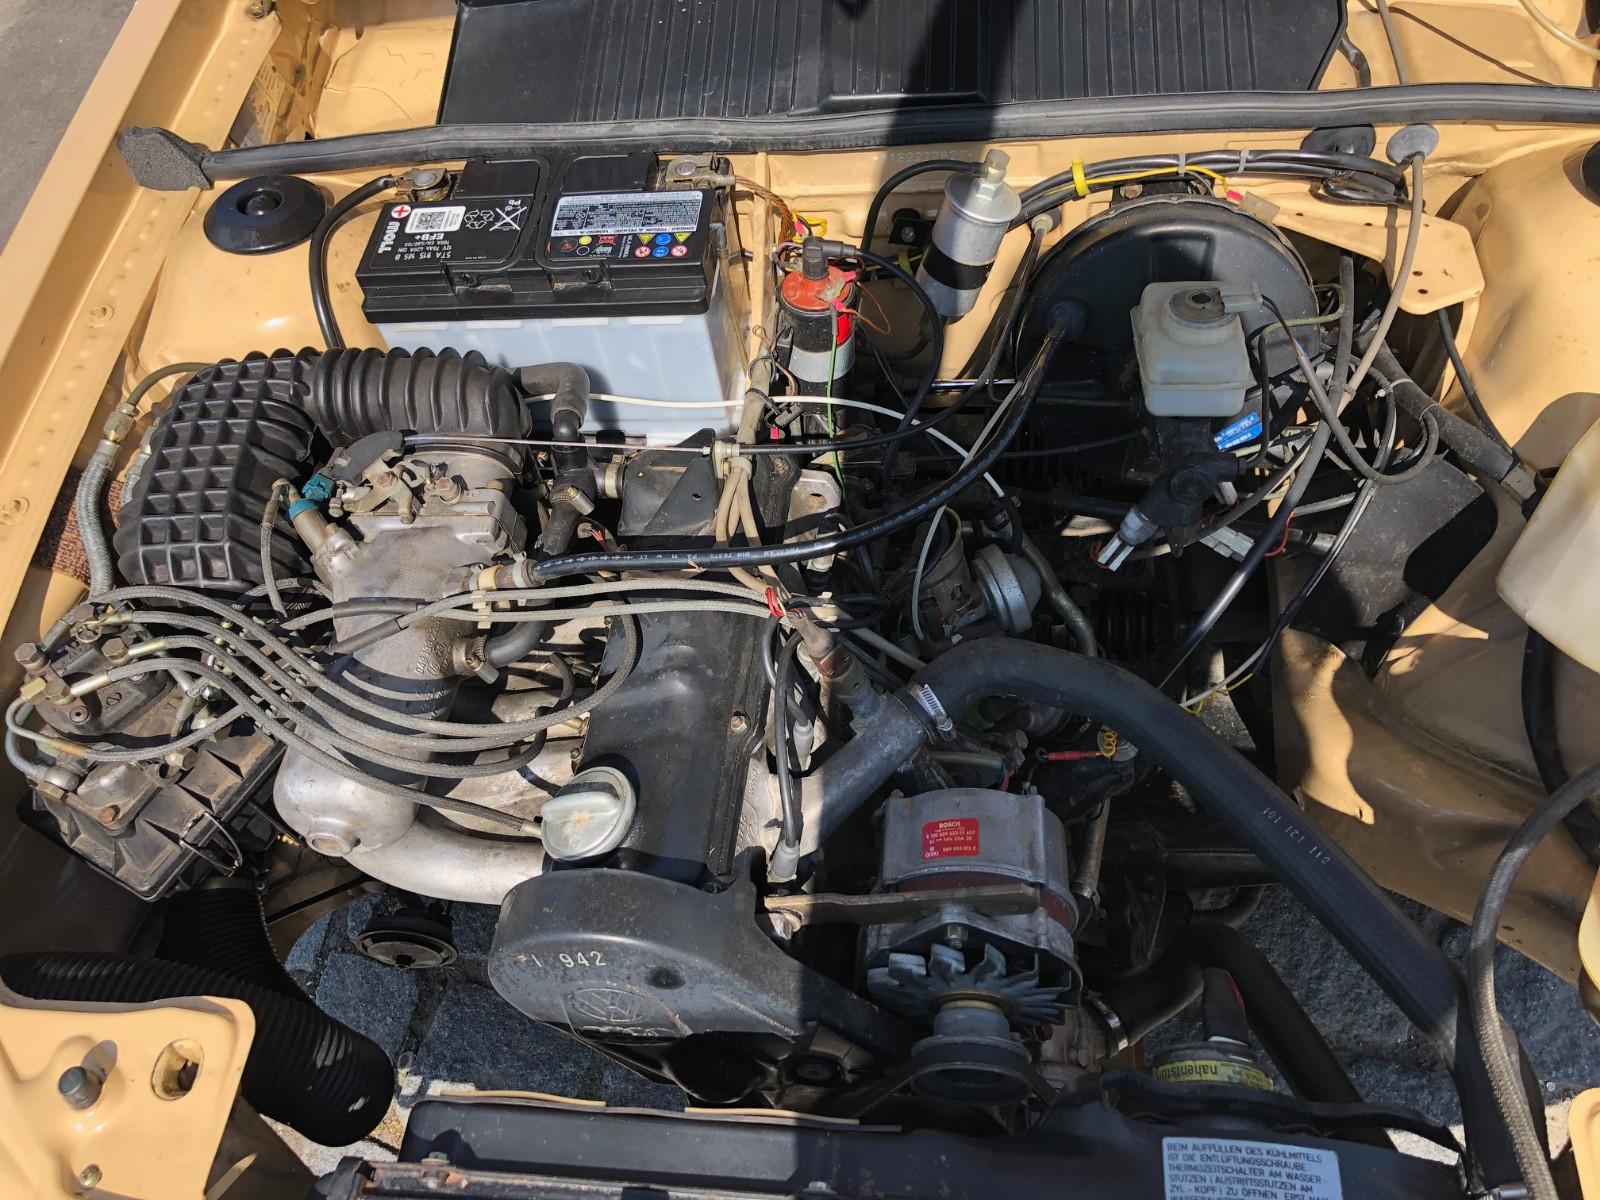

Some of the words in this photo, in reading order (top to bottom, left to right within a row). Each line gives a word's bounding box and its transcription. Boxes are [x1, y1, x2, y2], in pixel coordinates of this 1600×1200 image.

[414, 233, 445, 241] EFB+
[939, 821, 961, 829] BOSCH
[559, 951, 607, 968] 942
[1167, 1143, 1188, 1151] BEIM
[1246, 1147, 1264, 1156] DES
[1168, 1153, 1179, 1161] IST
[1182, 1153, 1196, 1161] DIE
[1268, 1170, 1282, 1178] AM
[1225, 1186, 1239, 1196] ZU
[1300, 1184, 1314, 1193] AM
